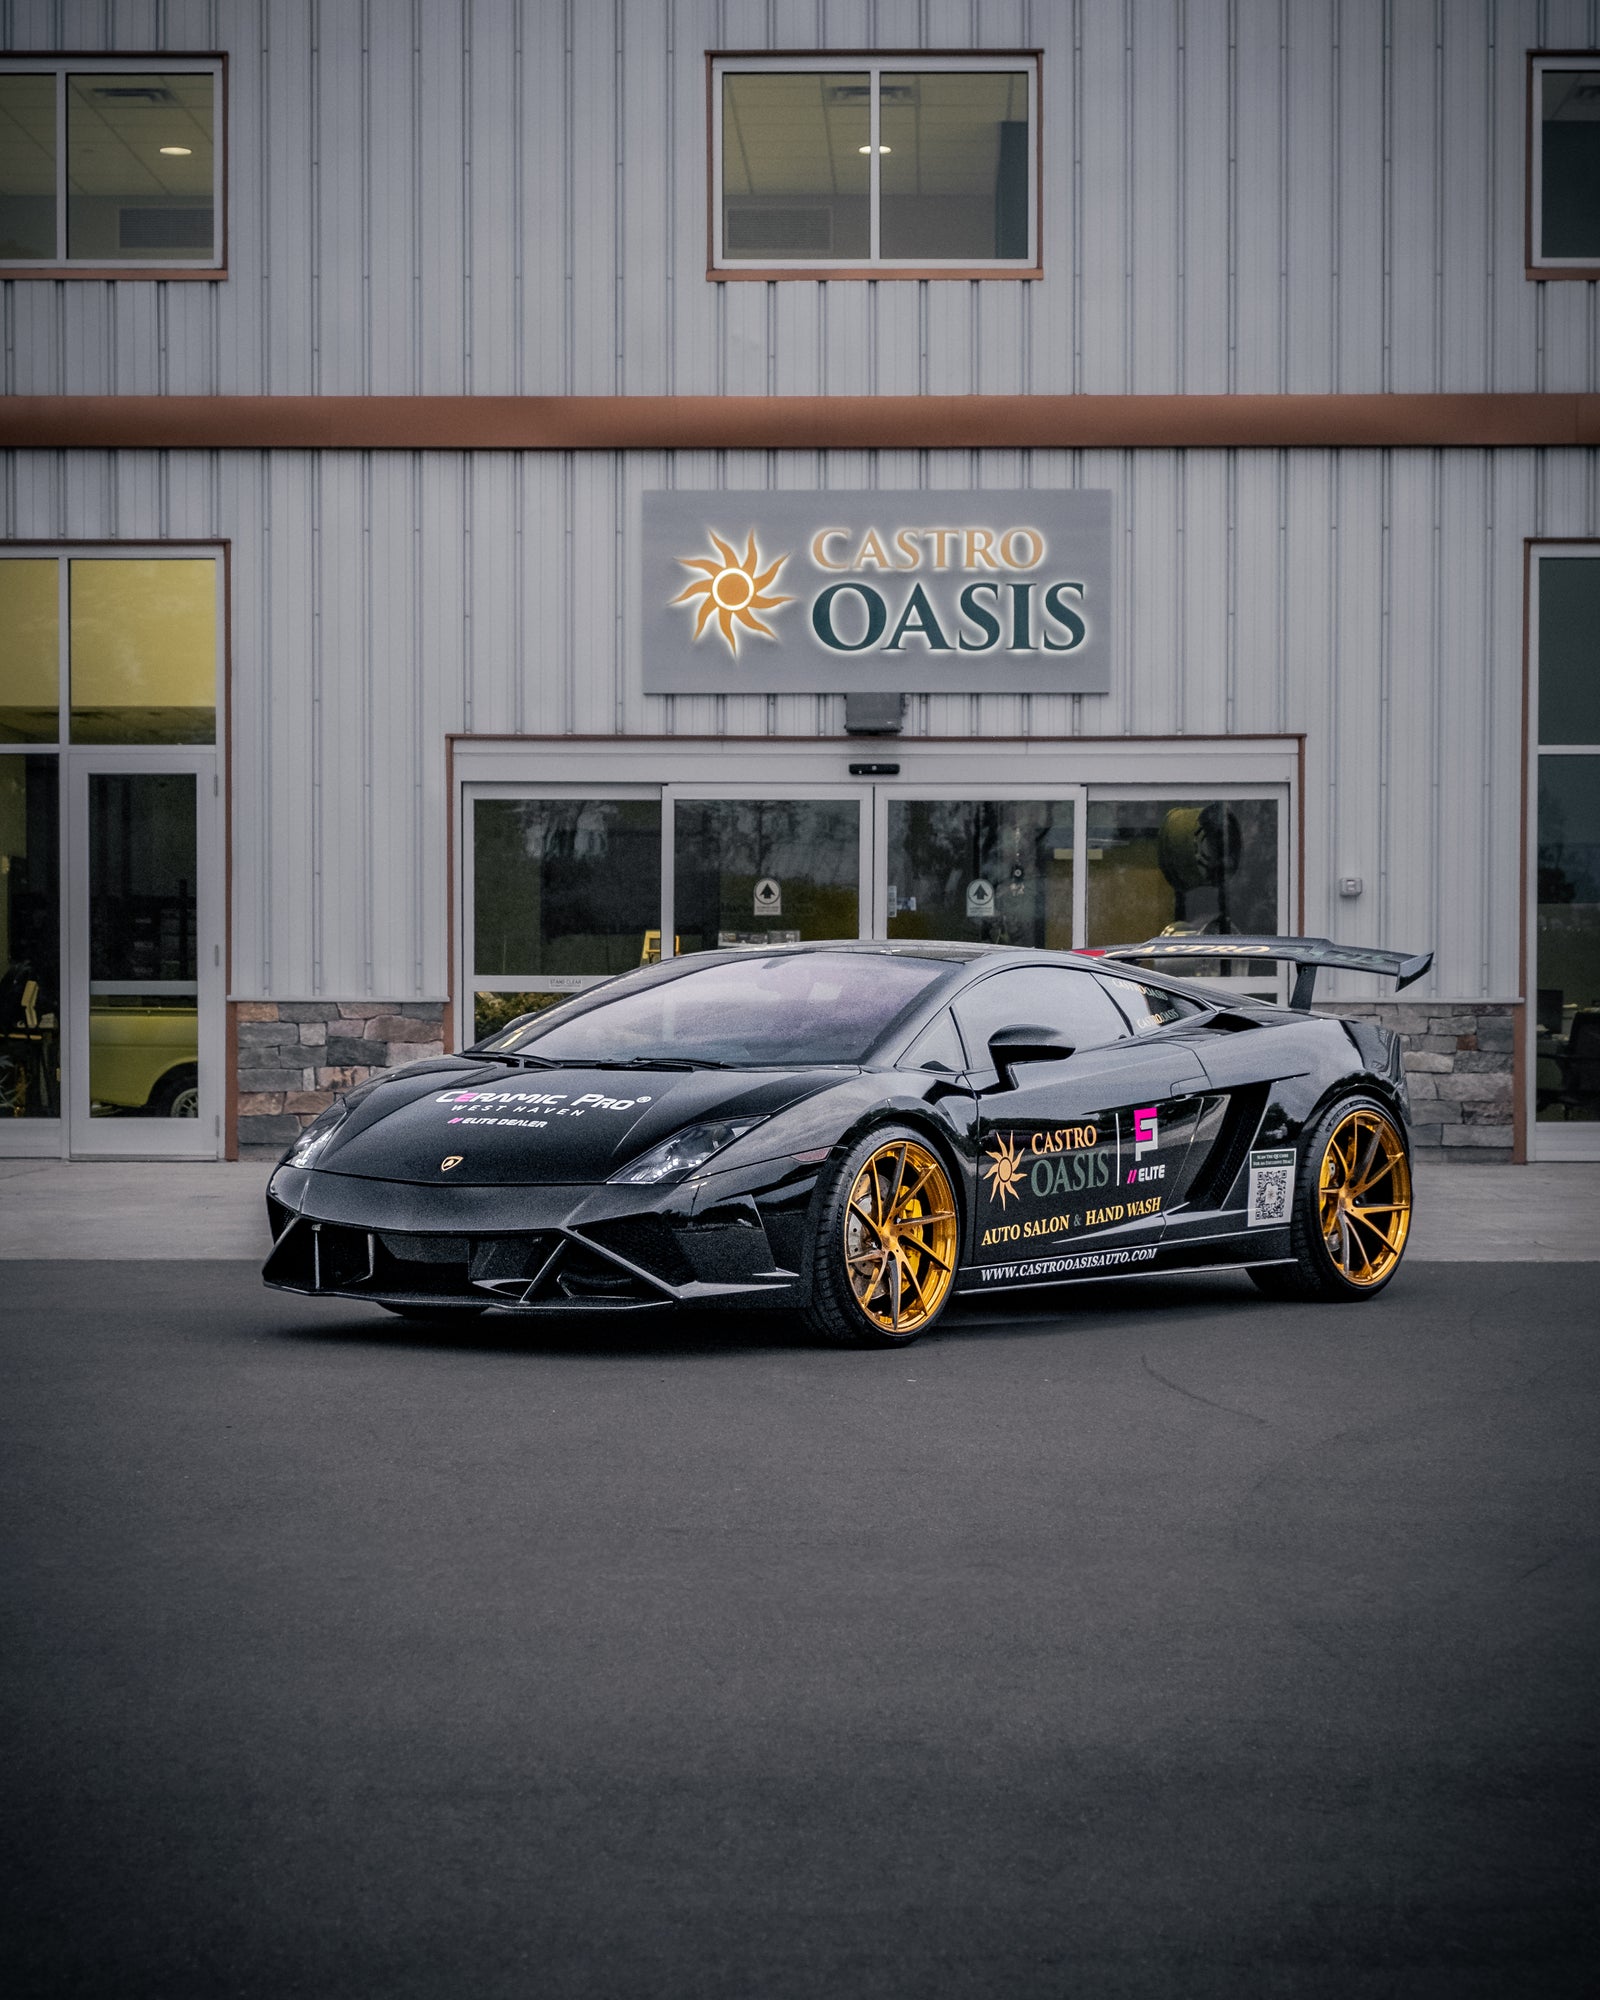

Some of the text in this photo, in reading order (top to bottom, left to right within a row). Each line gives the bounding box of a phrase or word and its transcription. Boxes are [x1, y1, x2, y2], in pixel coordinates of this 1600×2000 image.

[812, 527, 1045, 570] CASTRO
[811, 581, 1087, 652] OASIS
[435, 1090, 568, 1105] CERAMIC
[451, 1104, 586, 1117] WEST HAVEN
[497, 1118, 548, 1128] DEALER
[1031, 1125, 1097, 1155] CASTRO
[1030, 1149, 1109, 1197] OASIS
[981, 1196, 1162, 1247] AUTO SALON & HAND WASH
[980, 1247, 1158, 1282] WWW.CASTROOASISAUTO.COM
